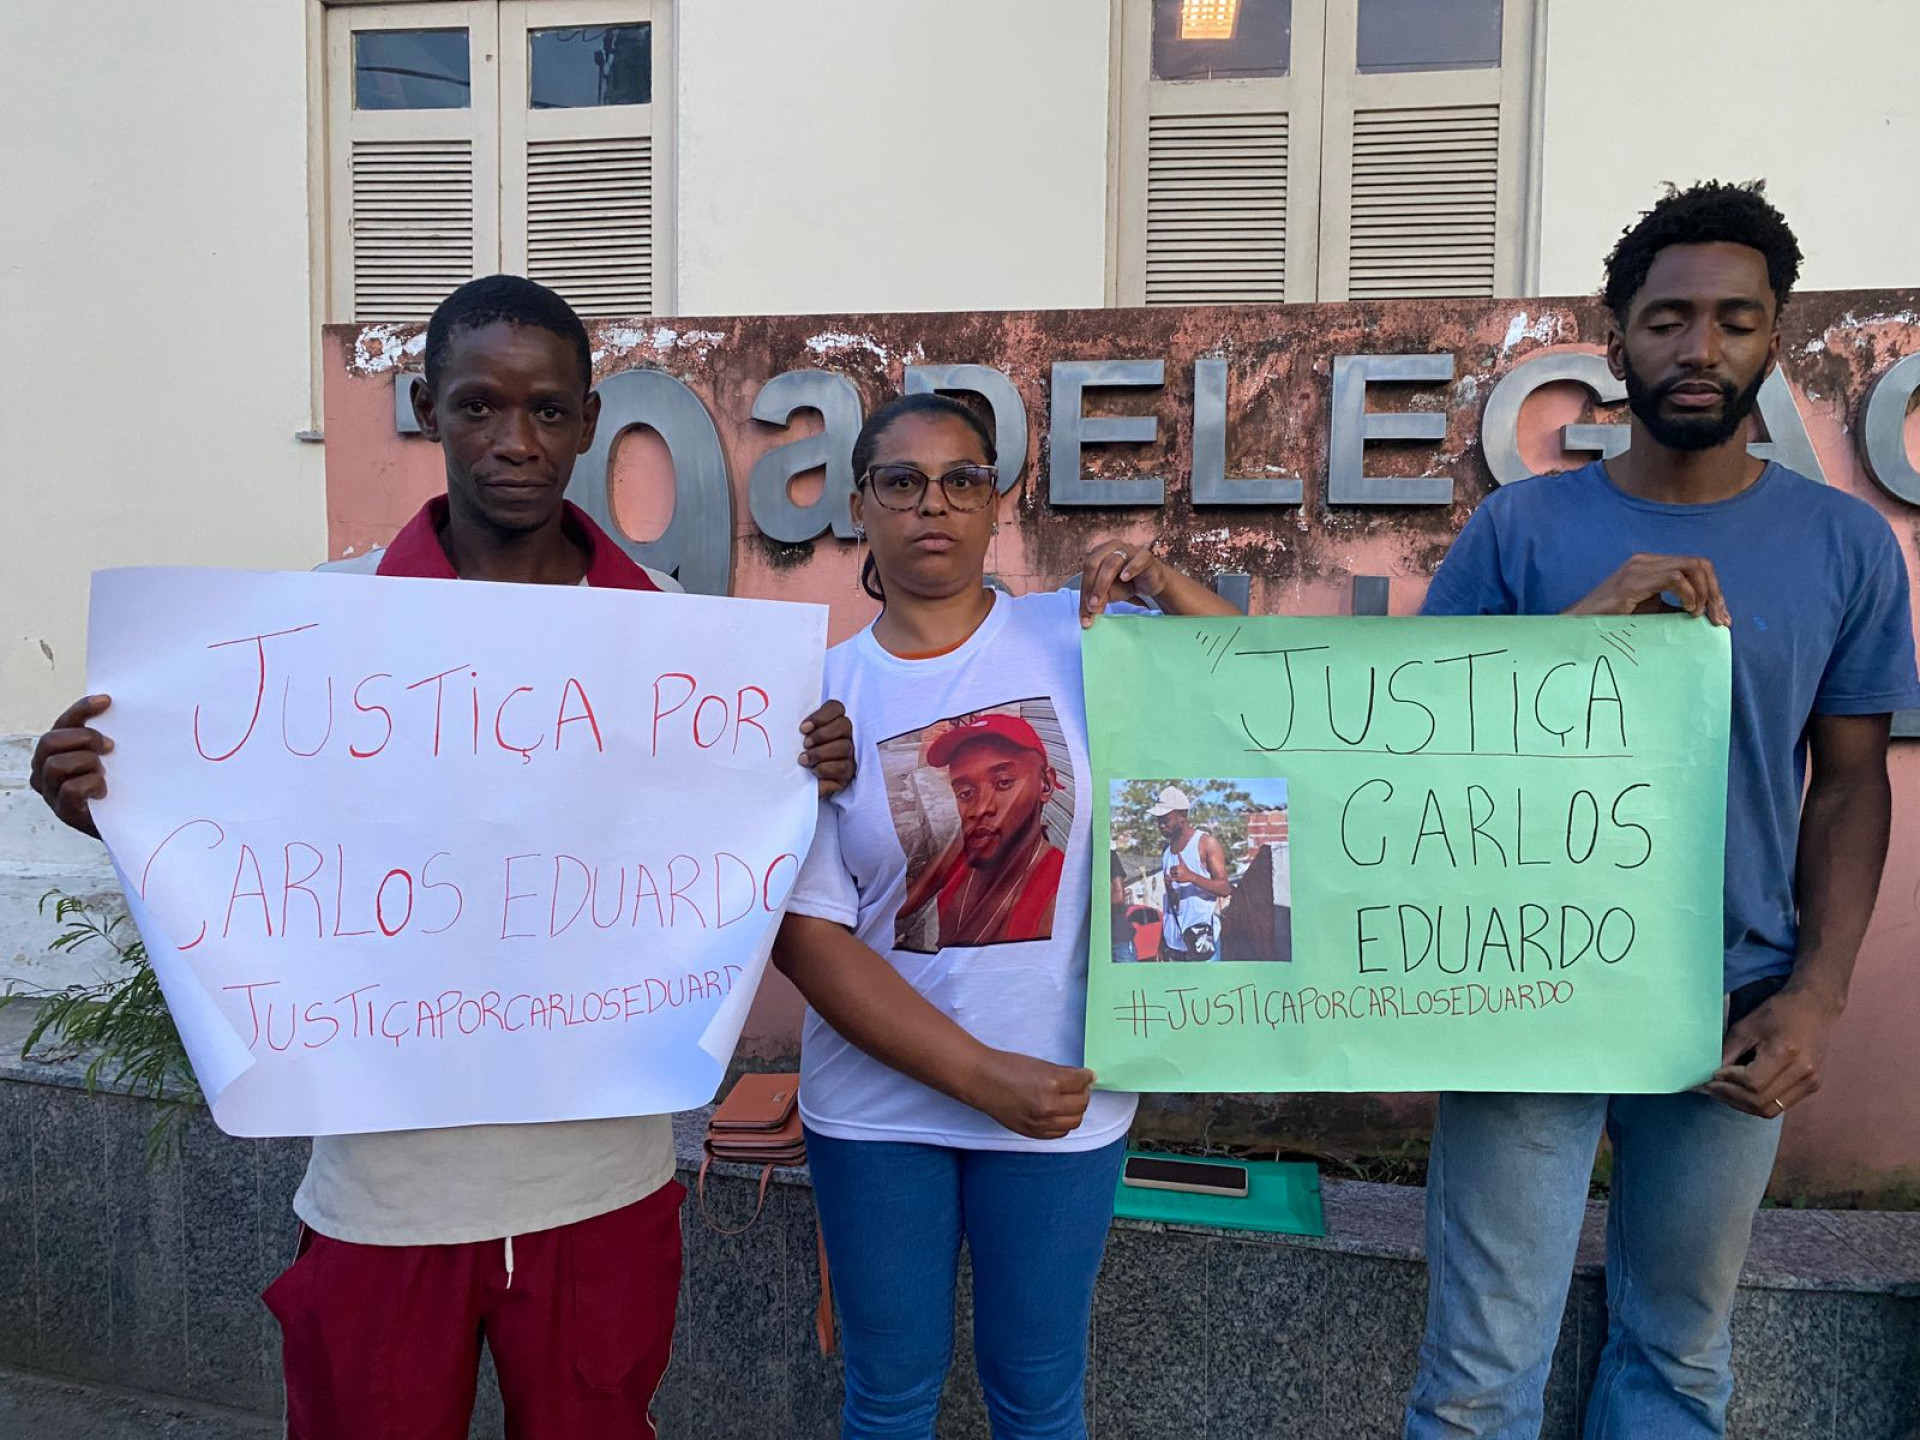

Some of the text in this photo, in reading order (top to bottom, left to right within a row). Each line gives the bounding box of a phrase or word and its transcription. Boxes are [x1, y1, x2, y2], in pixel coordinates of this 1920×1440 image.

[194, 623, 773, 764] JUSTIÇA POR
[1235, 645, 1628, 754] JUSTIÇA
[1341, 778, 1654, 869] CARLOS
[142, 819, 800, 951] CARLOS EDUARDO
[1357, 904, 1637, 974] EDUARDO
